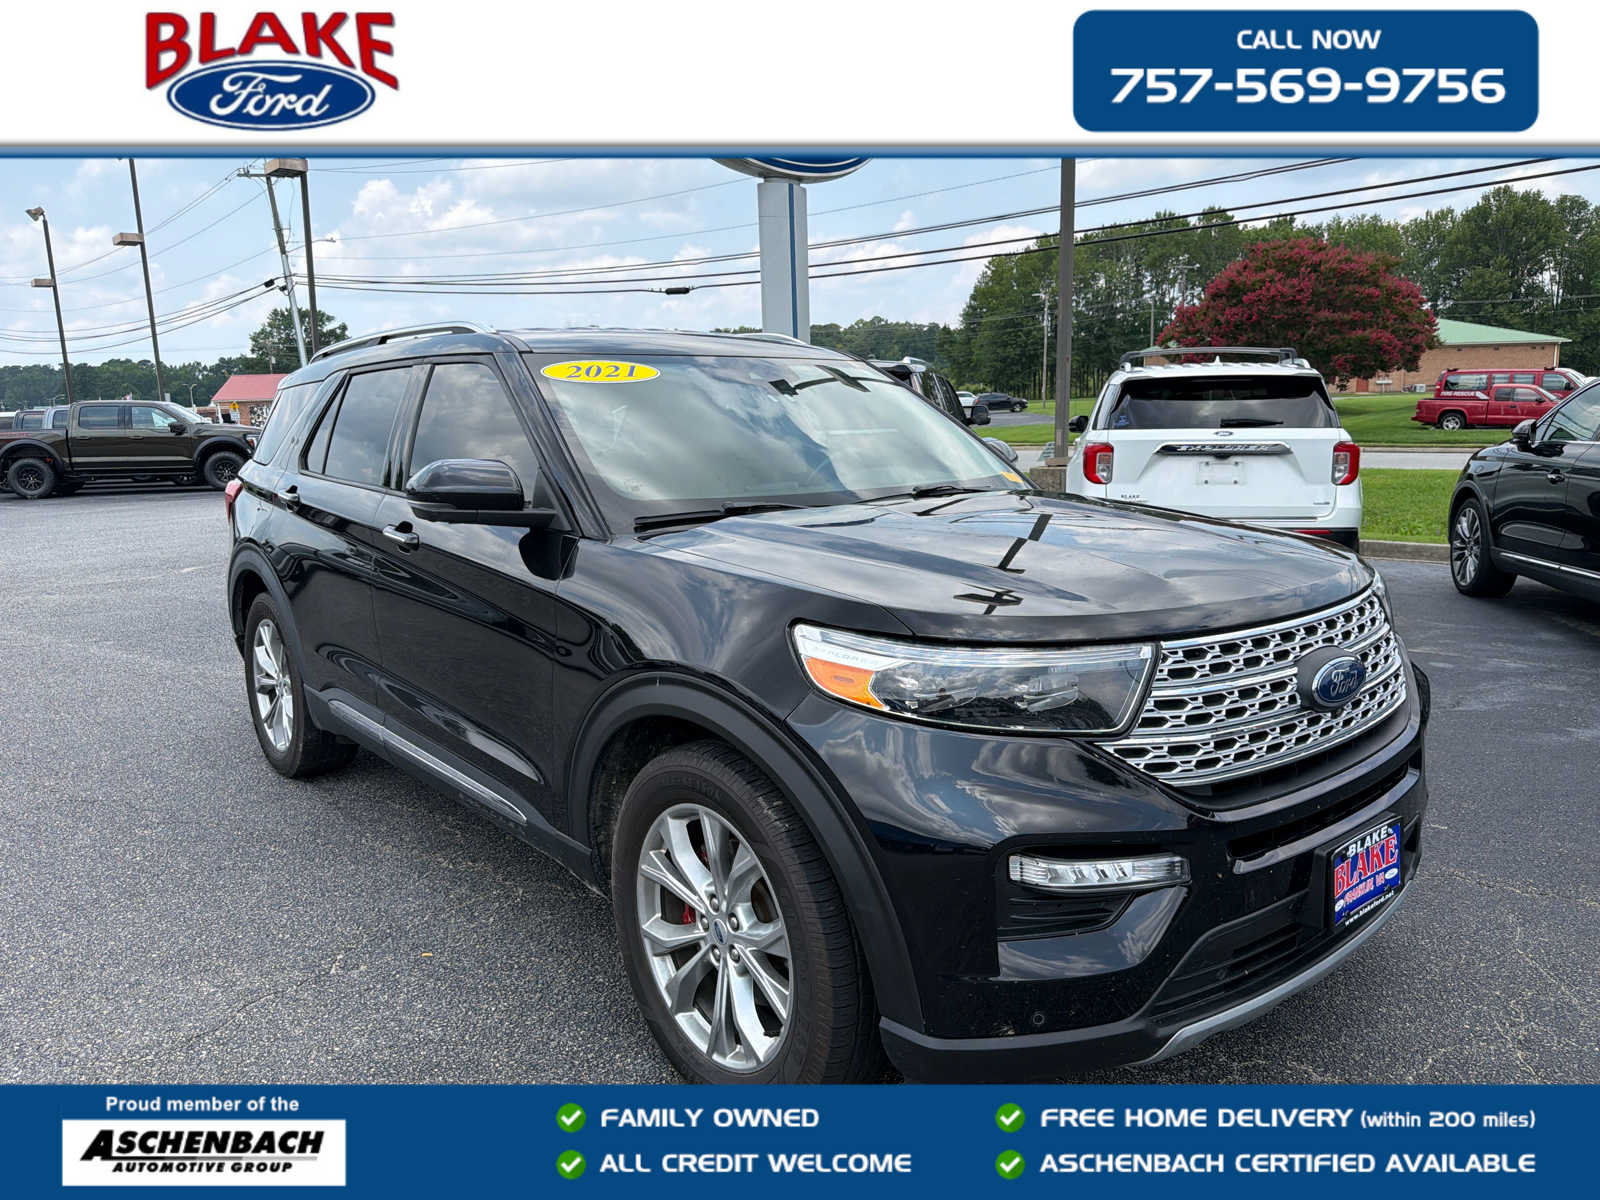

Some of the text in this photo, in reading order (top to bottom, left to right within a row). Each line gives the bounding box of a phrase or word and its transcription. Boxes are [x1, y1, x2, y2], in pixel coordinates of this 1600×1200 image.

[567, 365, 637, 378] 2021
[1330, 667, 1358, 697] Ford
[1347, 825, 1388, 857] BLAKE
[1334, 834, 1399, 899] BLAKE
